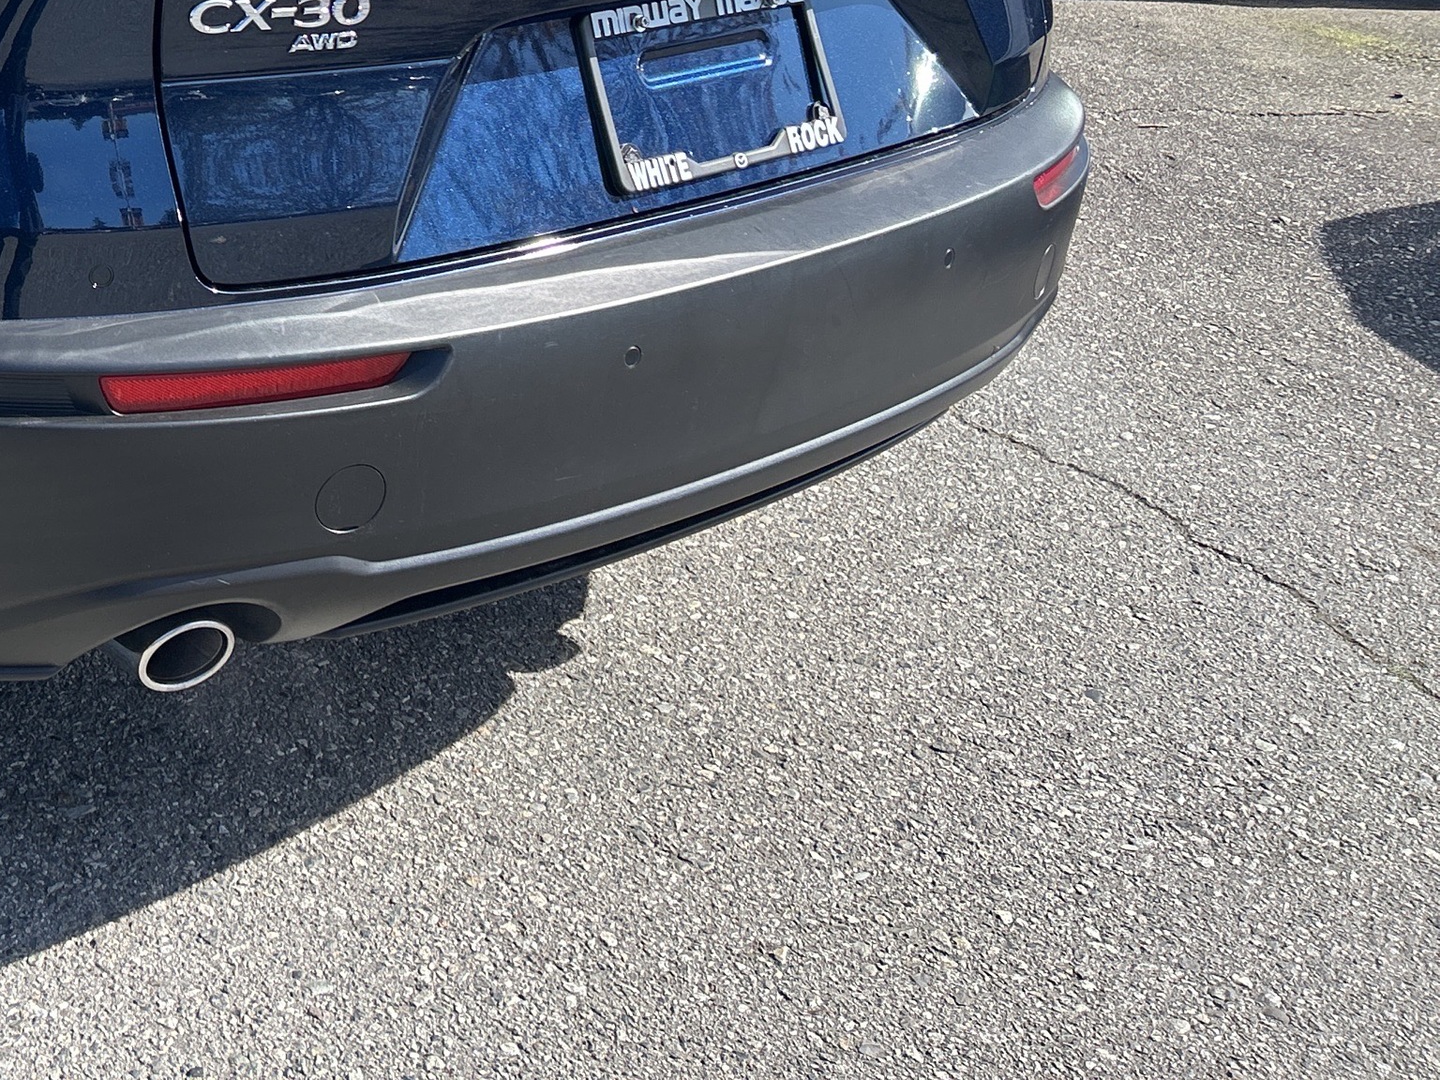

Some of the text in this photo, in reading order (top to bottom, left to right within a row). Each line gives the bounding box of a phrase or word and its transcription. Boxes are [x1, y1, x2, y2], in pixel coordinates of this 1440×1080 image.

[288, 30, 358, 53] AWD
[627, 117, 844, 191] WHITE ROCK
